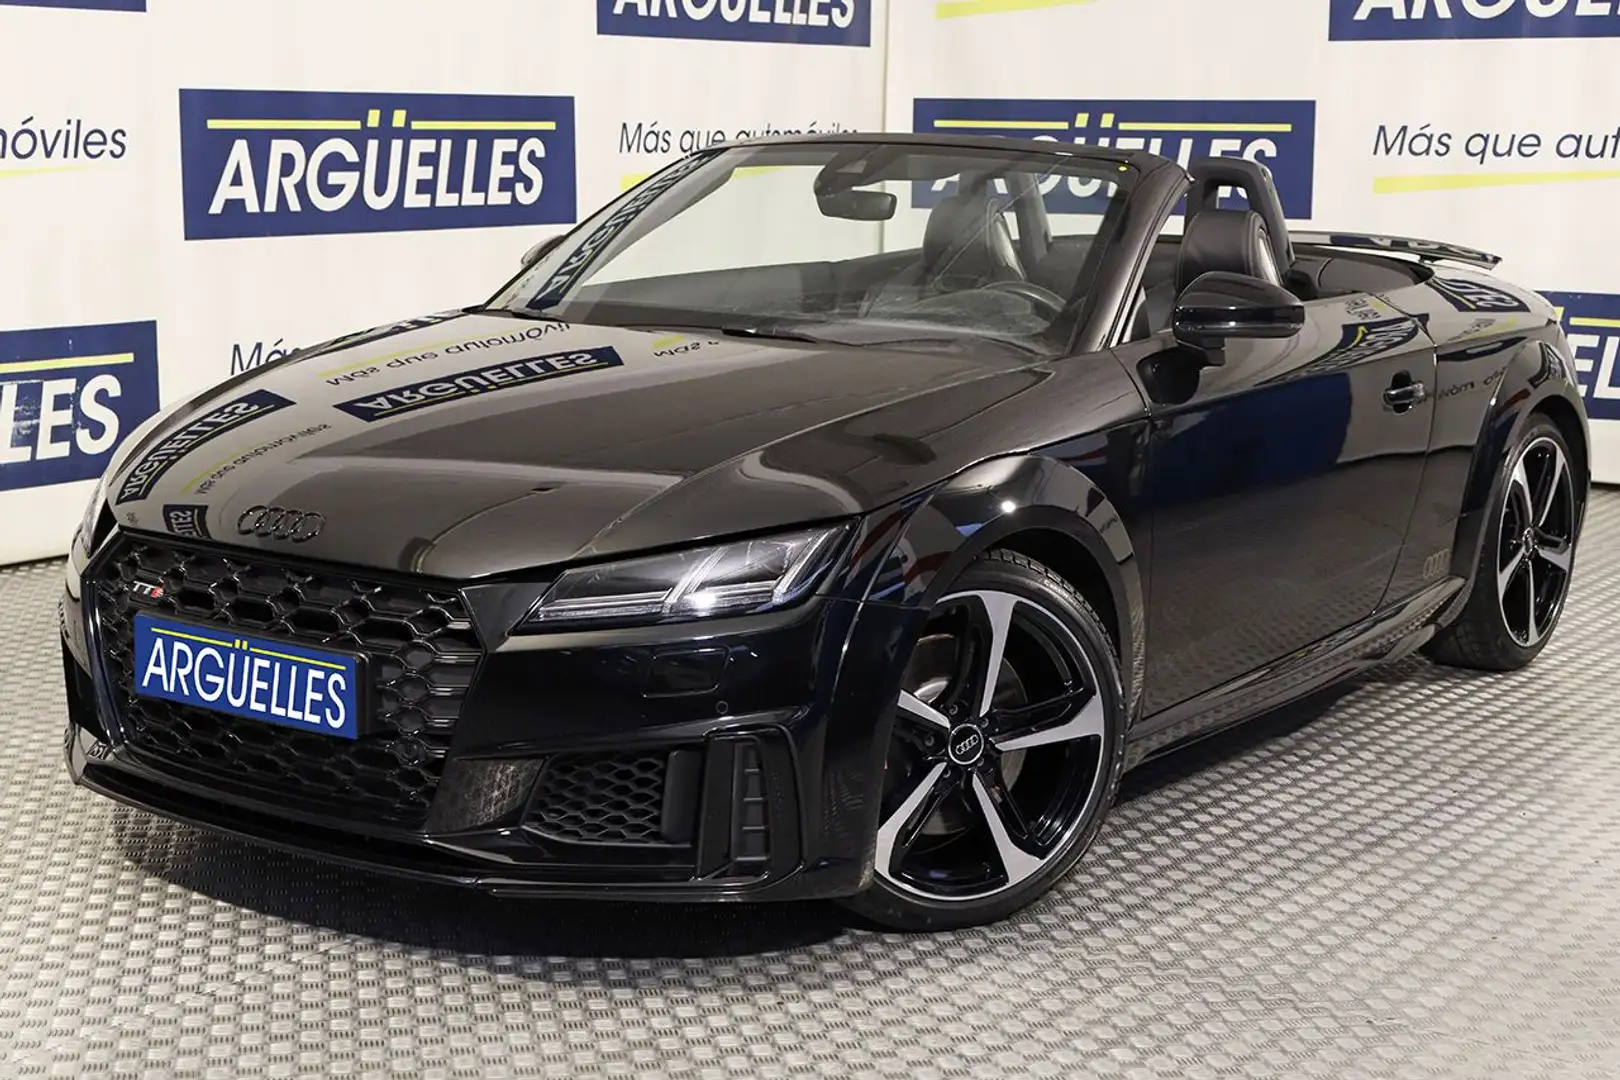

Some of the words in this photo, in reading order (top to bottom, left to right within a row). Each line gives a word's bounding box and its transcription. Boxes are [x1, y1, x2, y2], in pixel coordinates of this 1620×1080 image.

[0, 116, 127, 159] óviles
[208, 109, 546, 214] ARGÜELLES
[619, 121, 671, 153] Más
[1373, 123, 1451, 157] Más
[1465, 133, 1541, 164] que
[0, 374, 122, 465] LES
[141, 638, 347, 729] ARGÜELLES
